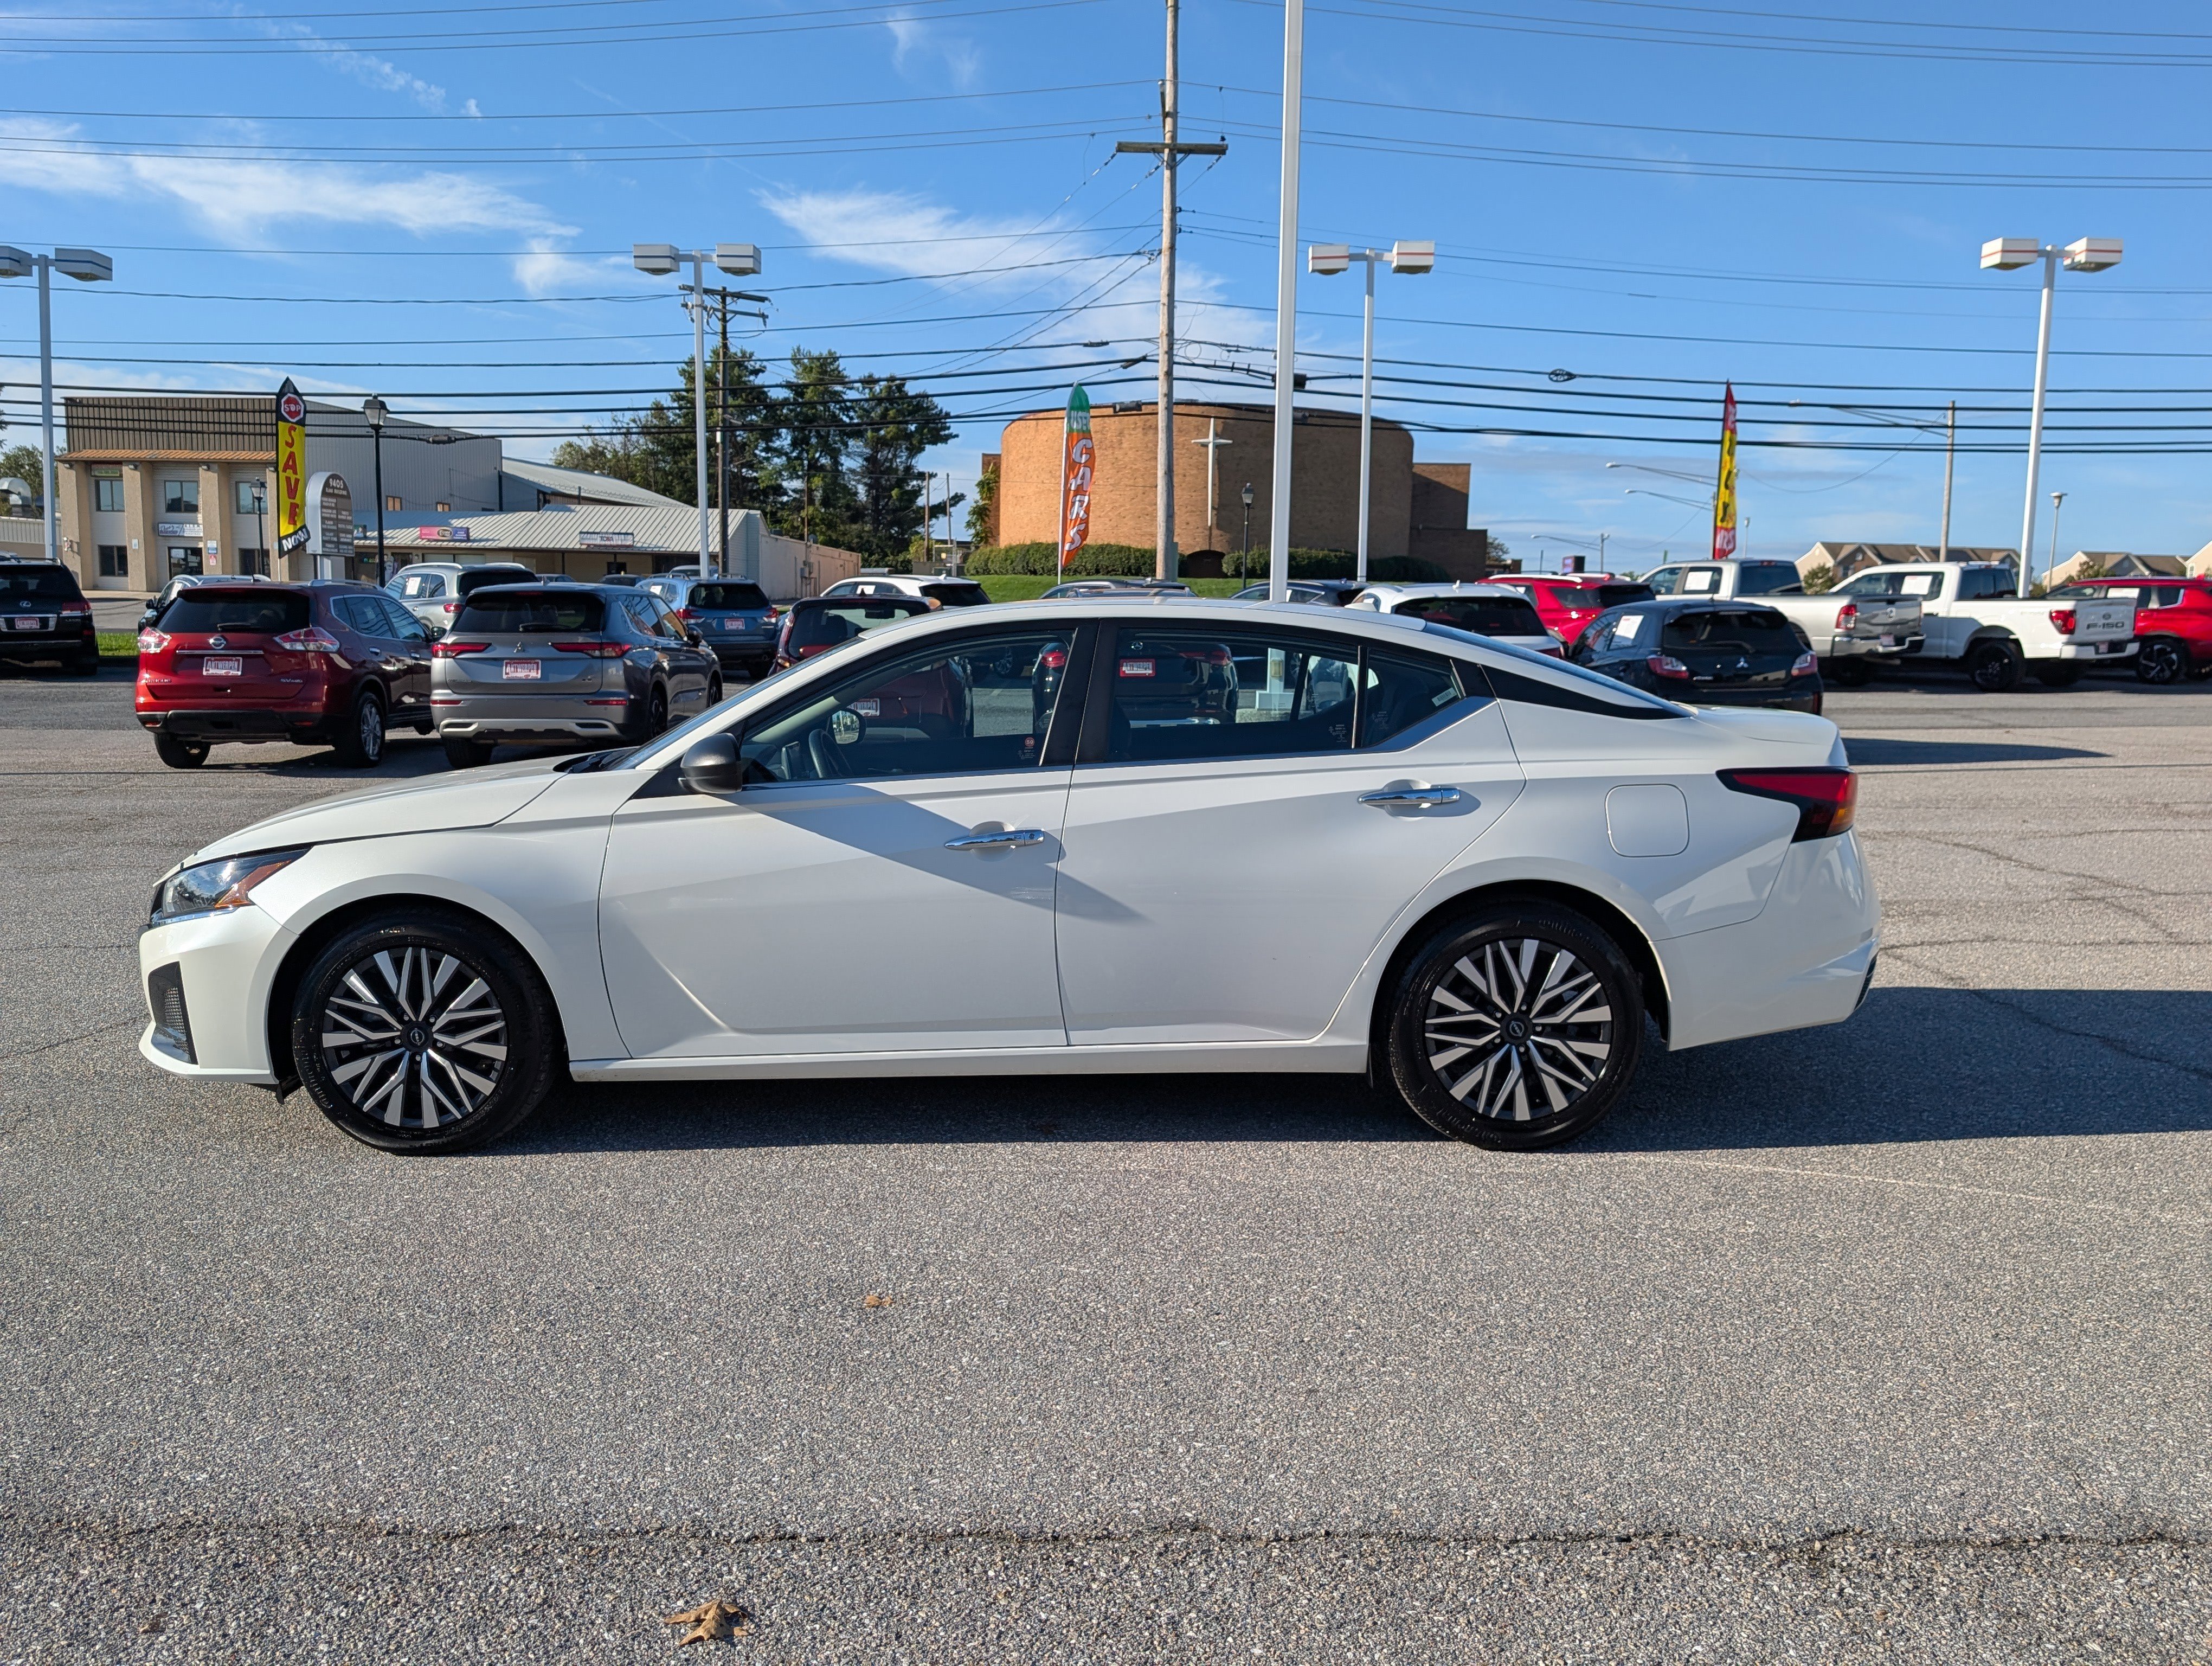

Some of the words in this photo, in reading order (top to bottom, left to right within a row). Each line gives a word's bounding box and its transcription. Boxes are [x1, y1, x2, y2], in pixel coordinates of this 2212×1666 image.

[281, 425, 300, 526] SAVE
[329, 478, 344, 489] 9405
[1065, 438, 1093, 550] CARS
[2086, 621, 2125, 630] F-150
[207, 661, 238, 671] ANTWERPEN
